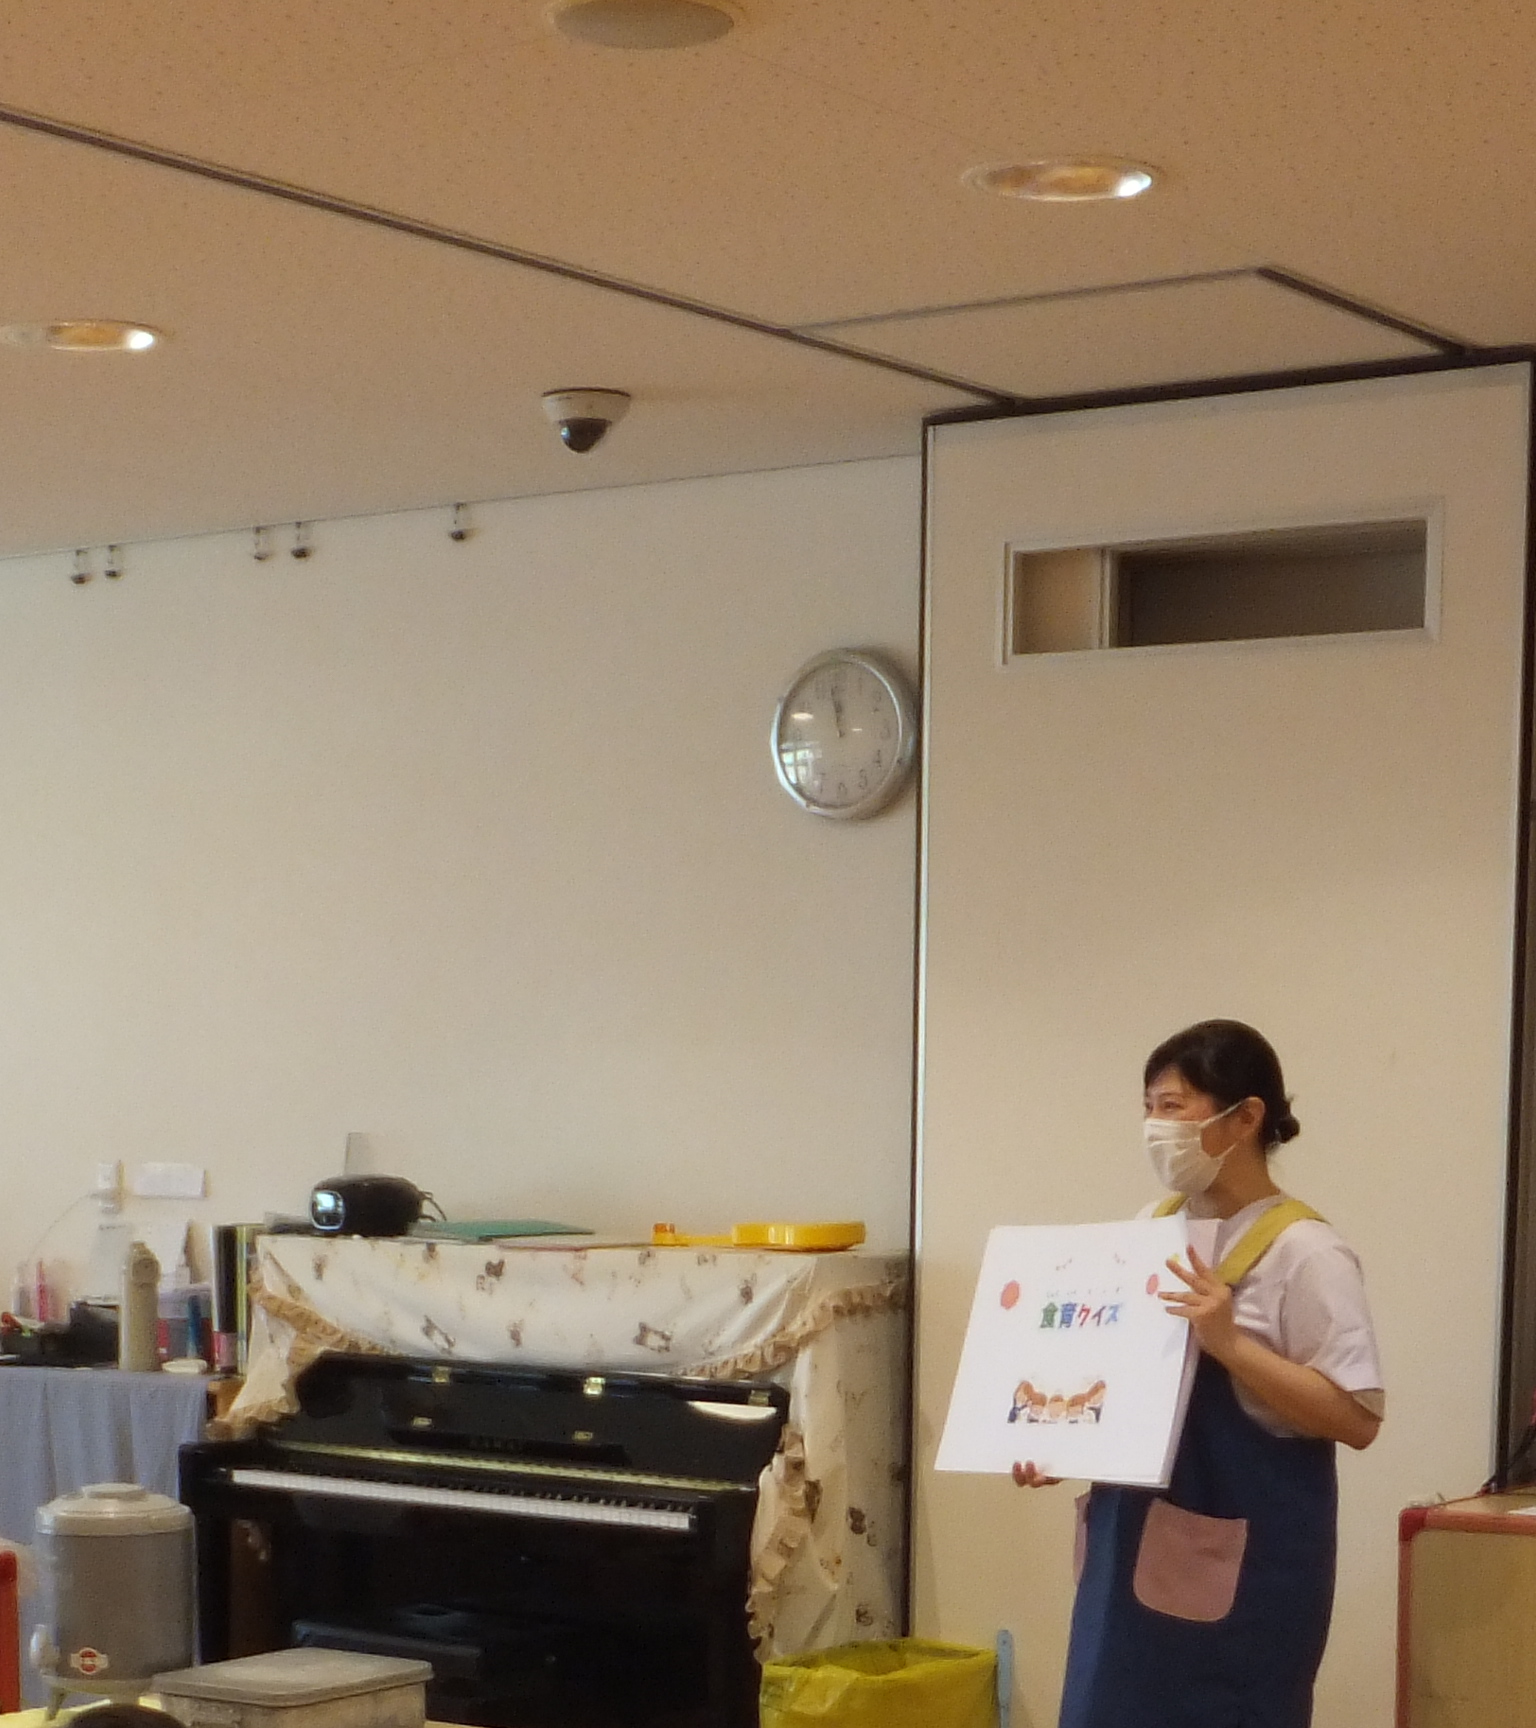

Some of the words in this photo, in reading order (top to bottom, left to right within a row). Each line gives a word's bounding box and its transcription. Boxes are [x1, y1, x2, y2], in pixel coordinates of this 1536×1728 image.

[1040, 1301, 1122, 1329] 食育クイズ
